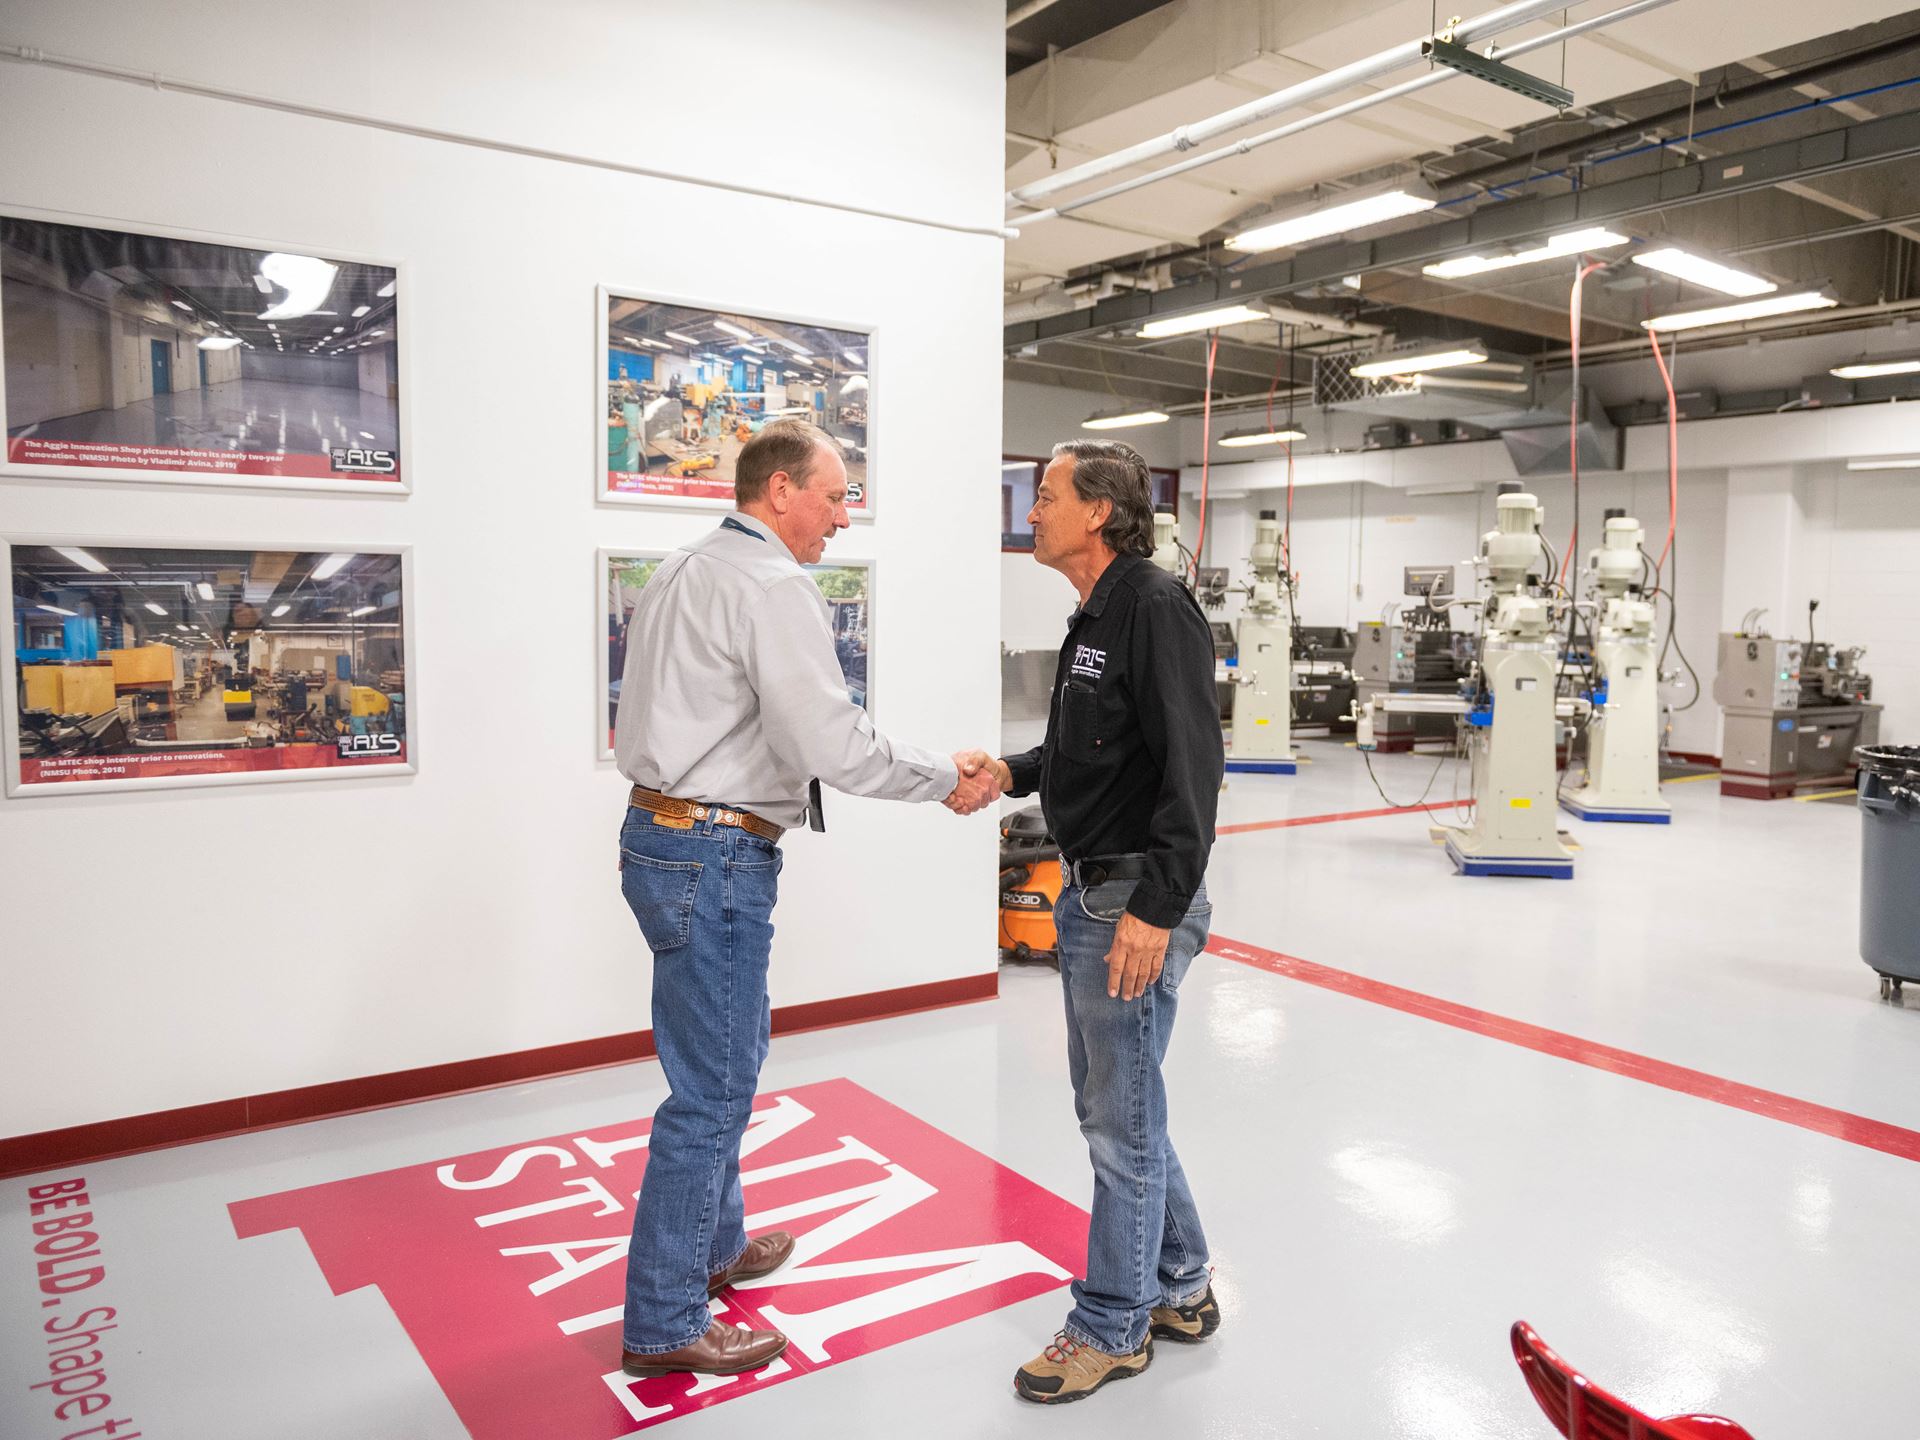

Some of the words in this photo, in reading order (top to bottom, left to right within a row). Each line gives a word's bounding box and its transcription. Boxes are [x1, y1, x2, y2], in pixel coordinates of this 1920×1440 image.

[24, 440, 41, 448] The
[43, 441, 69, 451] Aggie
[70, 443, 118, 453] Innovation
[120, 446, 141, 455] Shop
[143, 447, 178, 456] pictured
[180, 449, 207, 458] before
[209, 451, 220, 459] its
[221, 452, 247, 461] nearly
[248, 454, 284, 463] two-year
[25, 451, 77, 460] renovation.
[79, 453, 109, 462] (NMSU
[111, 454, 136, 463] Photo
[138, 456, 149, 465] by
[150, 457, 185, 466] Vladimir
[346, 449, 396, 471] AIS
[353, 733, 401, 753] AIS
[58, 758, 82, 767] MTEC
[84, 757, 105, 766] shop
[106, 756, 139, 764] interior
[141, 755, 161, 763] prior
[174, 752, 225, 761] renovations.
[40, 768, 71, 778] (NMSU
[72, 767, 101, 776] Photo,
[102, 766, 126, 775] 2018)
[27, 1177, 91, 1217] BE
[32, 1211, 106, 1308] BOLD.
[29, 1306, 118, 1421] Shape
